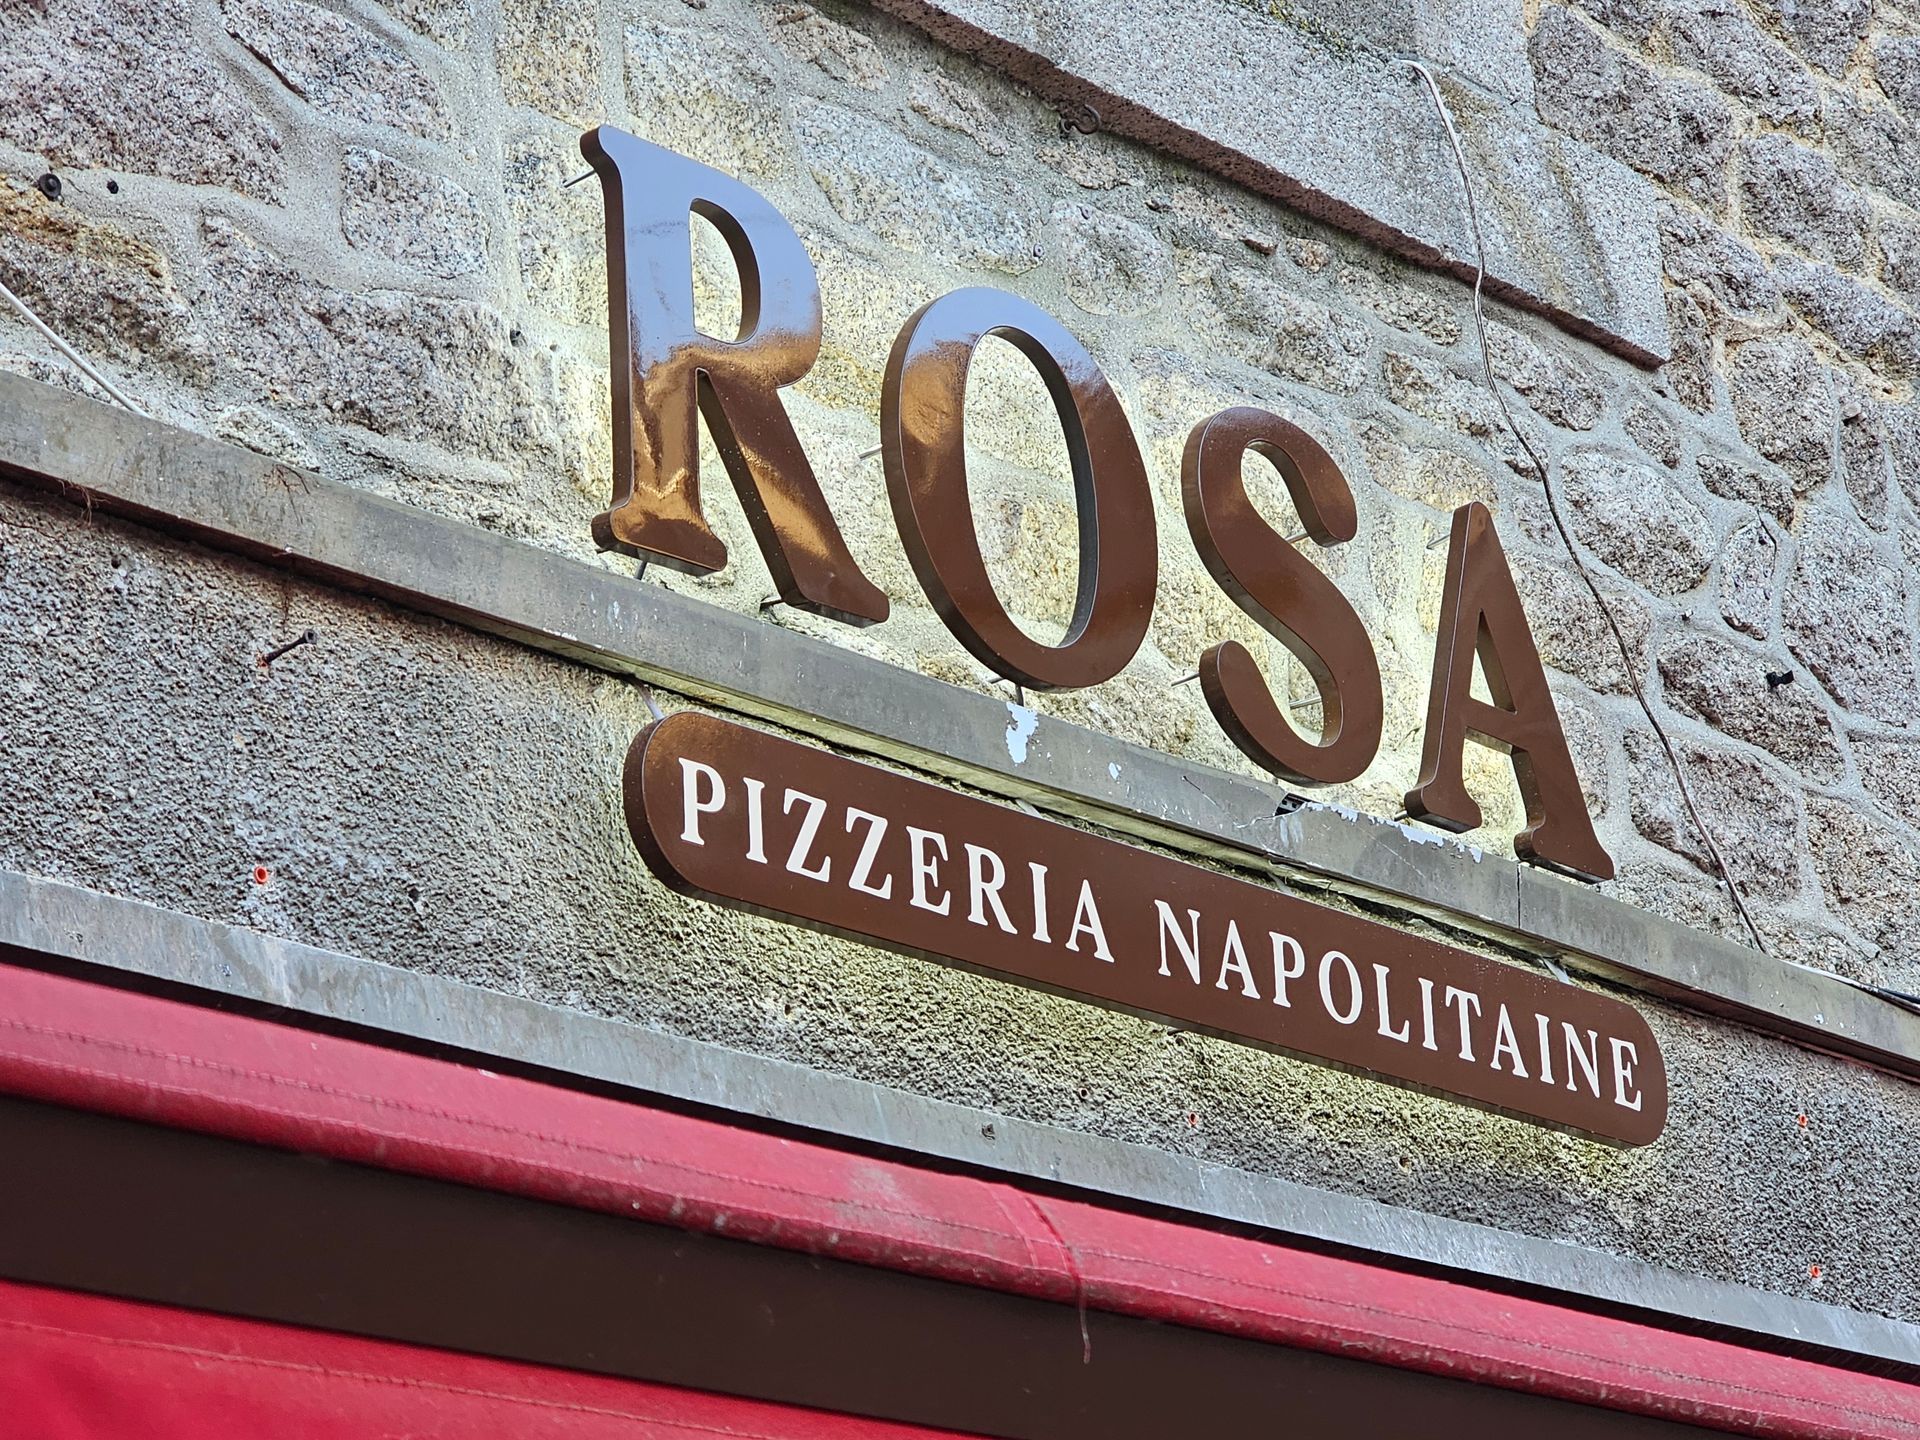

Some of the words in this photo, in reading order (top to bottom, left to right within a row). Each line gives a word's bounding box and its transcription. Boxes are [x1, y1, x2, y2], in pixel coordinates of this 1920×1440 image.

[580, 124, 1616, 883] ROSA
[678, 757, 1115, 963] PIZZERIA
[1154, 898, 1643, 1112] NAPOLITAINE
